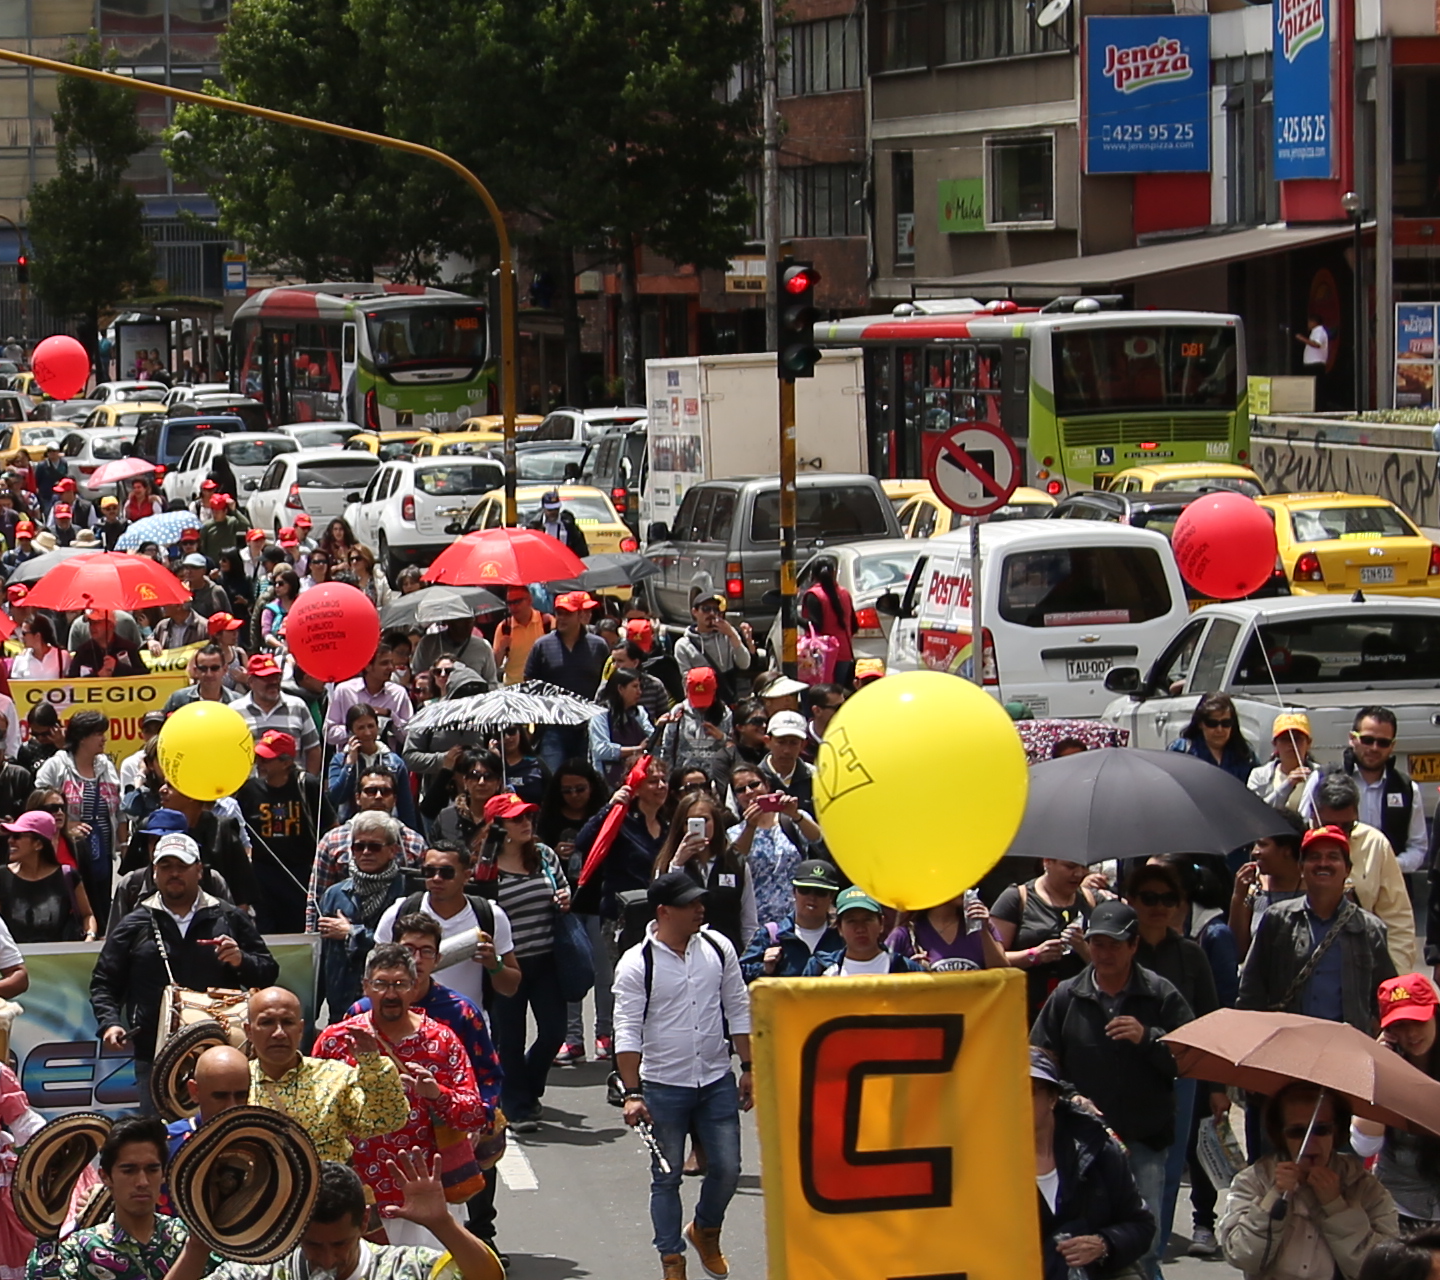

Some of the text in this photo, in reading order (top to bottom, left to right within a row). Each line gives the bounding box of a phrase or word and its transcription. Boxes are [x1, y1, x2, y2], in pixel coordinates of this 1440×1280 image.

[1103, 37, 1180, 76] Jeno's
[1115, 54, 1188, 90] pizza
[1113, 123, 1194, 140] 425 95 25
[1282, 115, 1325, 143] 425 95 25
[1103, 140, 1194, 152] www.jenospizza.com
[25, 685, 157, 704] COLEGIO
